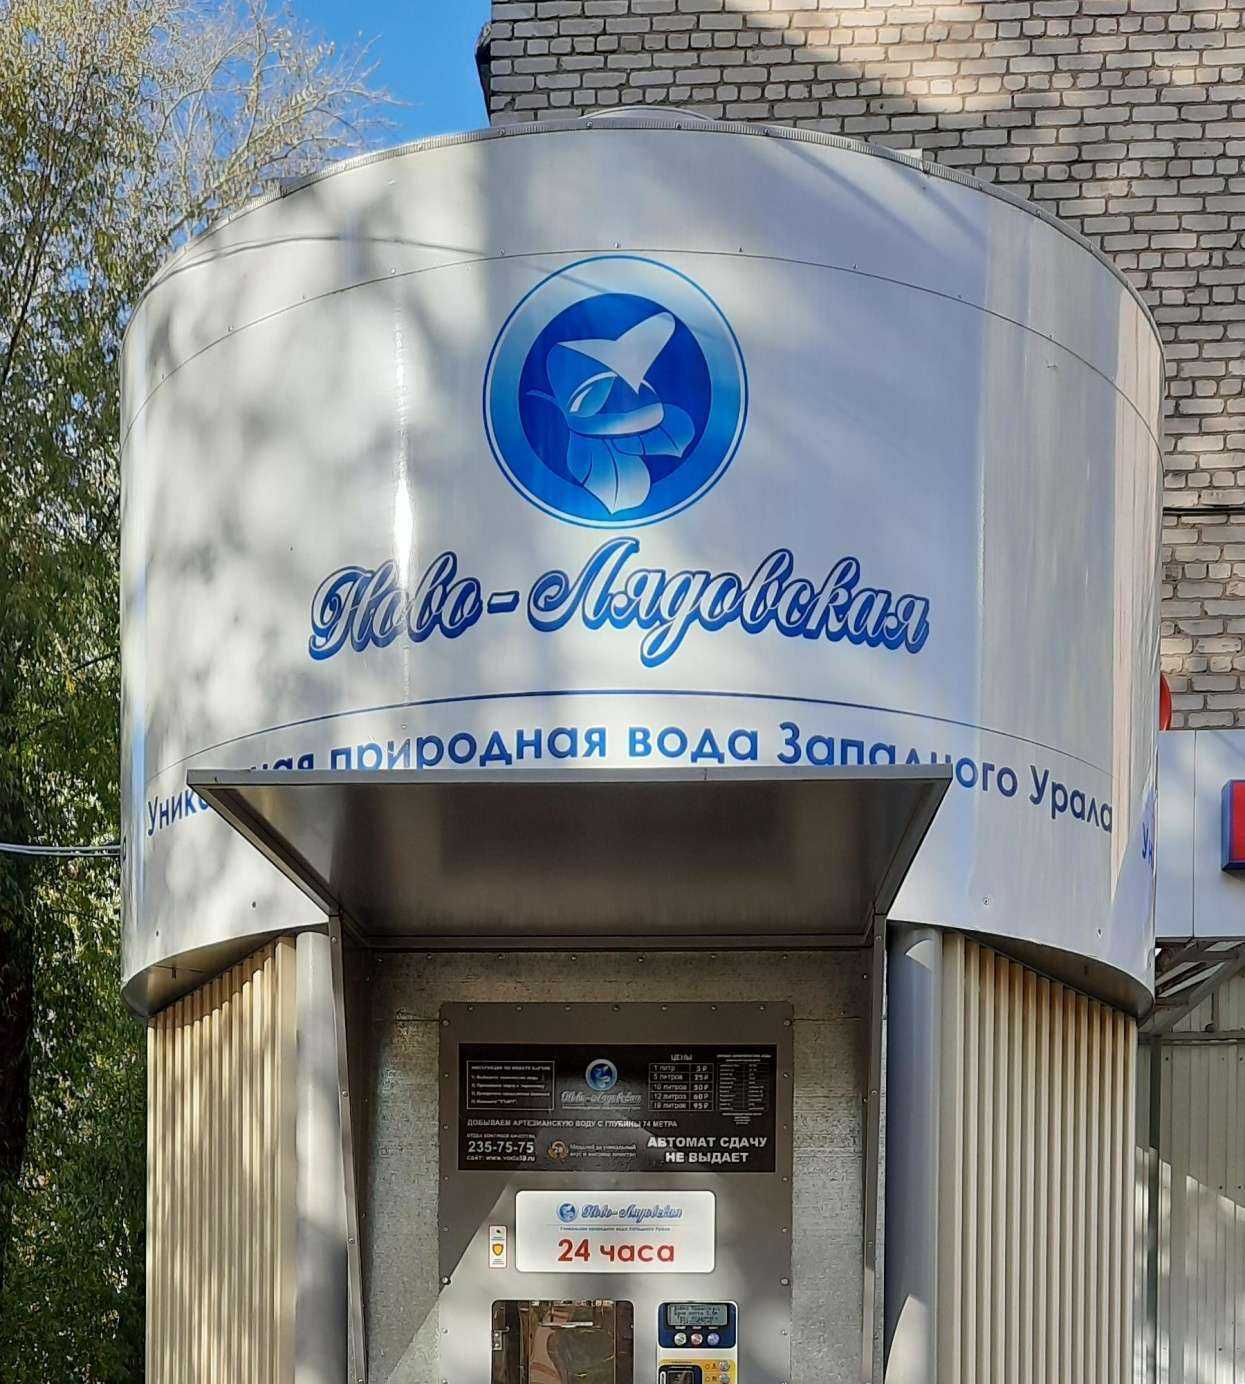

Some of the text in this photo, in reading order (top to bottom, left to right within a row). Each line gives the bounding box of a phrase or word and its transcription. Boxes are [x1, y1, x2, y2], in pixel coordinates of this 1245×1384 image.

[308, 536, 930, 668] Ново-Лядовская
[331, 728, 607, 770] природная
[628, 726, 759, 764] вода
[1029, 765, 1112, 833] Урала
[467, 1119, 511, 1127] ДОБЫВАЕМ
[513, 1120, 574, 1128] АРТЕЗИАНСКУЮ
[575, 1120, 596, 1128] ВОДУ
[468, 1140, 535, 1153] 235-75-75
[647, 1136, 767, 1149] АВТОМАТ СДАЧУ
[665, 1151, 749, 1164] НЕ ВЫДАЕТ
[557, 1238, 675, 1263] 24 часа
